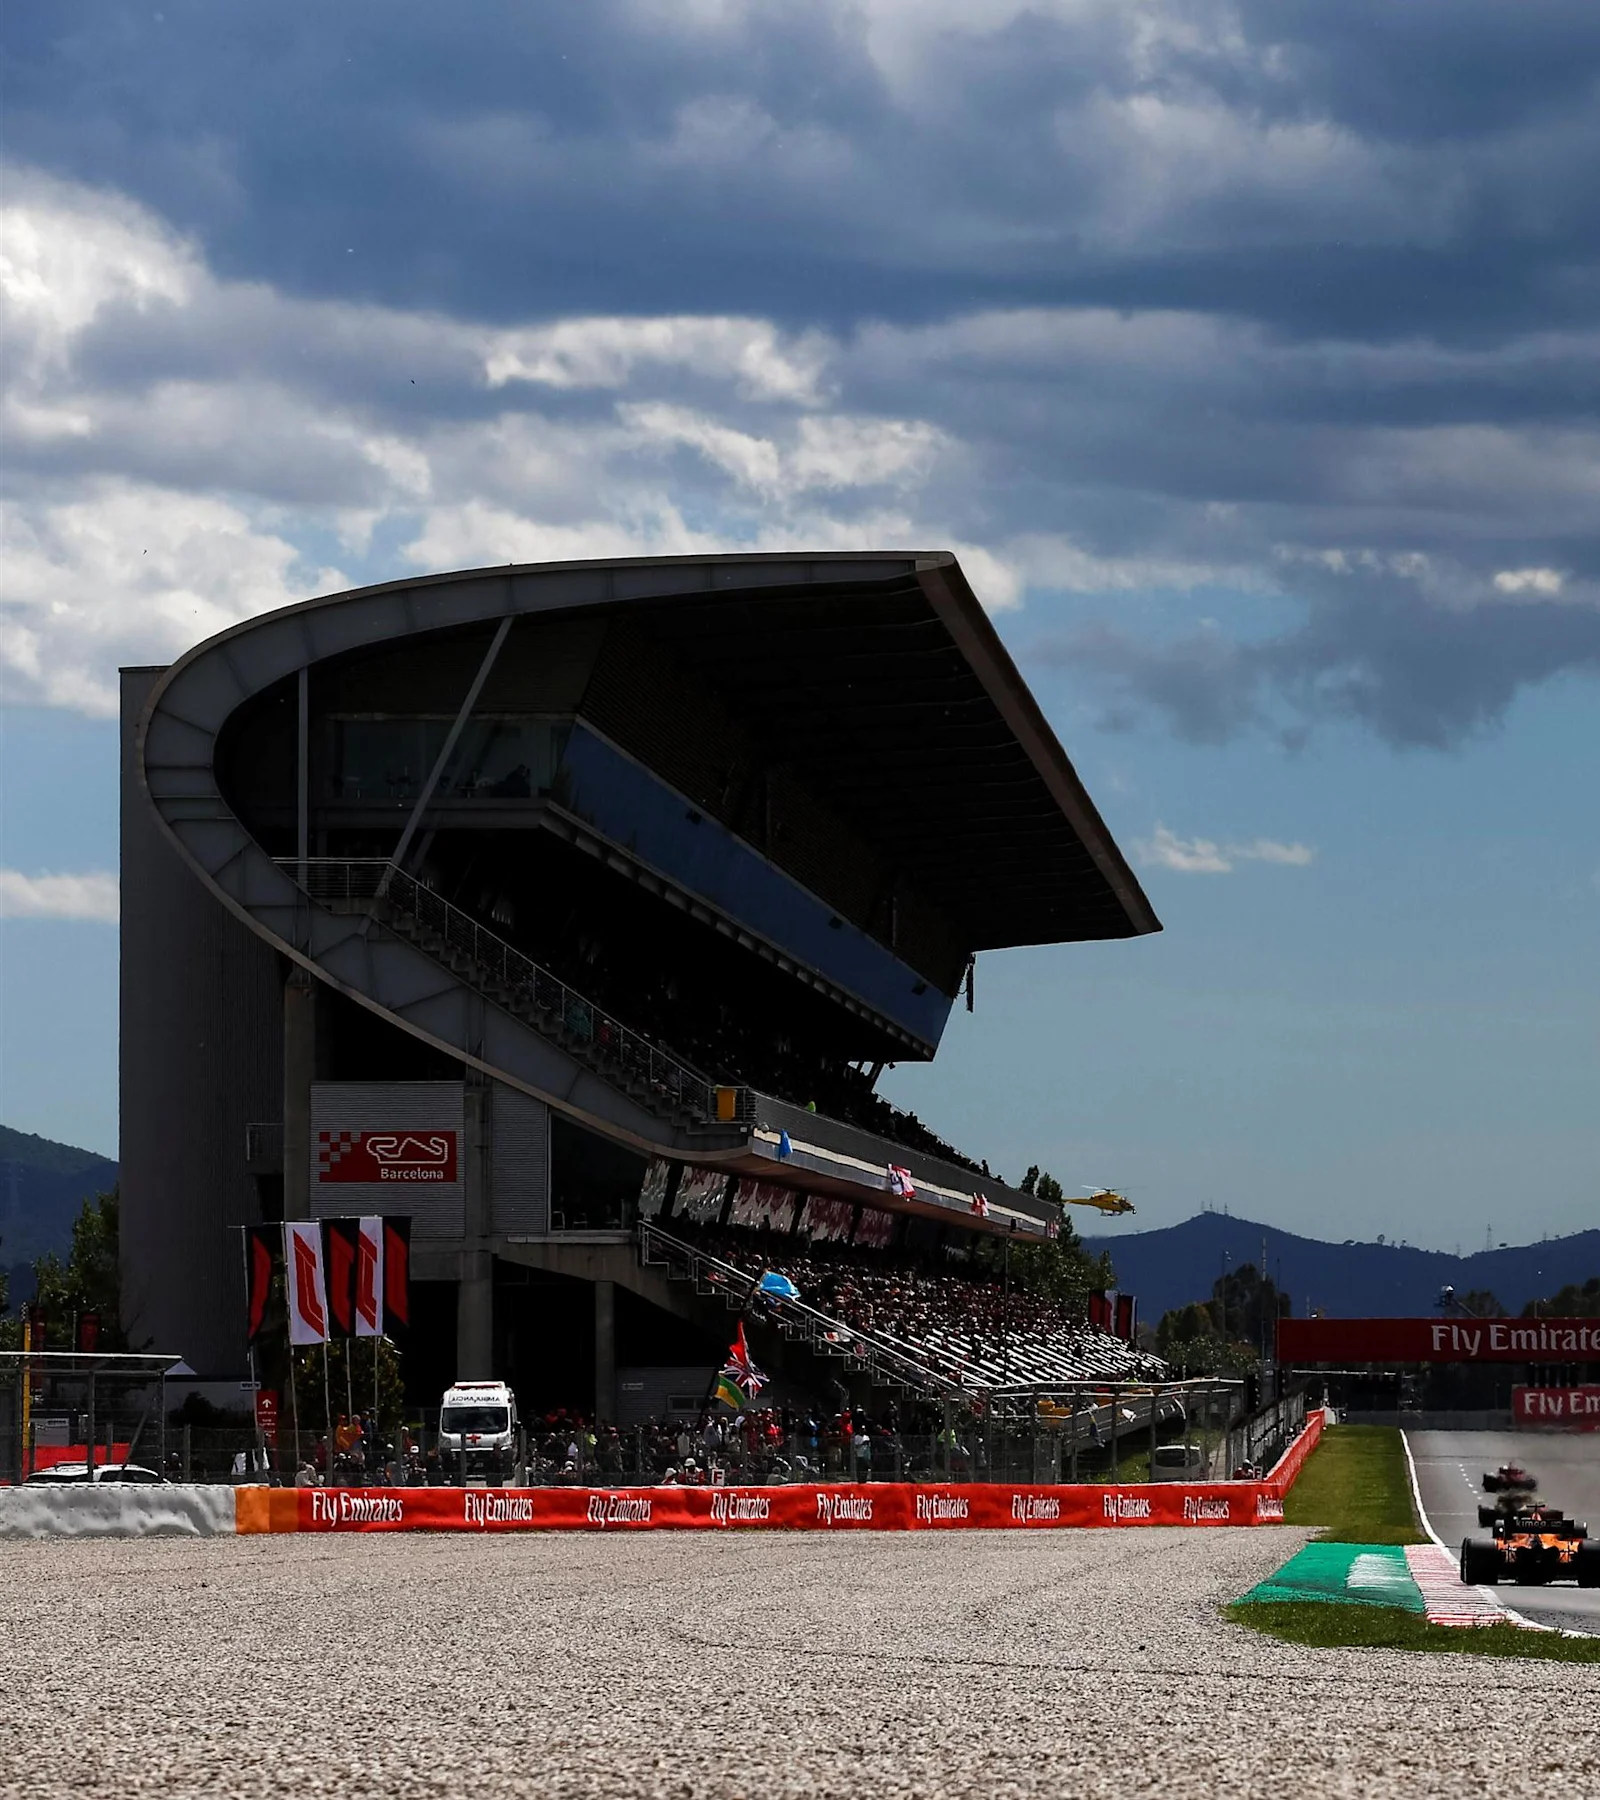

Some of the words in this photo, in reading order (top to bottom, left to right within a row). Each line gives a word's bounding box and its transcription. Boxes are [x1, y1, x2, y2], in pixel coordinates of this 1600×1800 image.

[380, 1168, 444, 1179] Barcelona
[1431, 1325, 1481, 1356] Fly
[714, 1471, 723, 1484] F
[313, 1491, 337, 1526] Fly
[341, 1491, 403, 1521] Emirates
[465, 1493, 484, 1526] Fly
[486, 1492, 533, 1520] Emirates
[588, 1496, 607, 1527] Fly
[608, 1494, 651, 1521] Emirates
[710, 1493, 729, 1525] Fly
[729, 1492, 770, 1519] Emirates
[817, 1493, 834, 1525] Fly
[834, 1493, 873, 1519] Emirates
[917, 1495, 932, 1523] Fly
[932, 1493, 968, 1519] Emirates
[1012, 1494, 1026, 1522] Fly
[1027, 1494, 1060, 1519] Emirates
[1104, 1494, 1117, 1522] Fly
